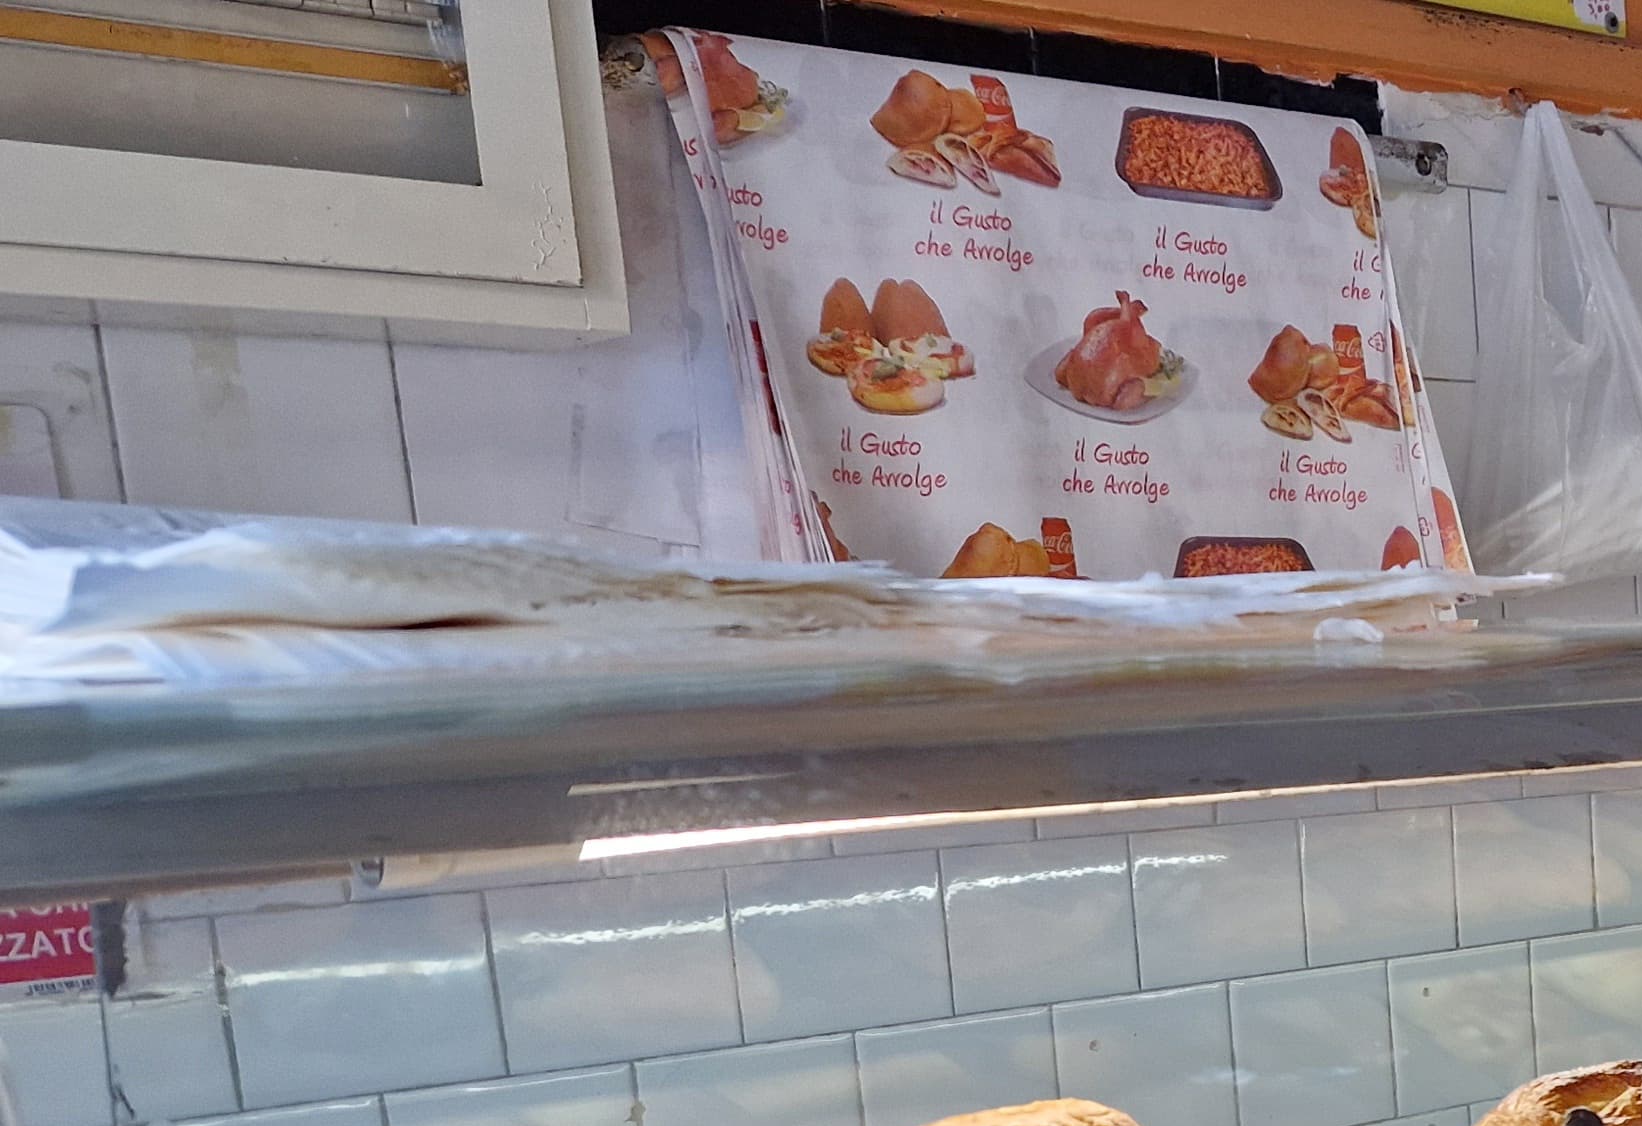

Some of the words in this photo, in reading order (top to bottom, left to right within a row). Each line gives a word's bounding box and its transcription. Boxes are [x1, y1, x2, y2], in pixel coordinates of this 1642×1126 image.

[930, 199, 943, 224] il
[952, 205, 1012, 231] Gusto
[914, 230, 952, 257] che
[1155, 224, 1167, 249] il
[1174, 231, 1228, 256] Gusto
[1142, 253, 1175, 280] che
[1353, 249, 1364, 272] il
[1341, 276, 1371, 300] che
[841, 426, 851, 452] il
[860, 432, 922, 456] Gusto
[1074, 437, 1085, 463] il
[1094, 443, 1150, 466] Gusto
[832, 457, 862, 485] che
[1280, 449, 1290, 473] il
[1296, 454, 1348, 476] Gusto
[1062, 467, 1094, 493] che
[1269, 477, 1296, 502] che
